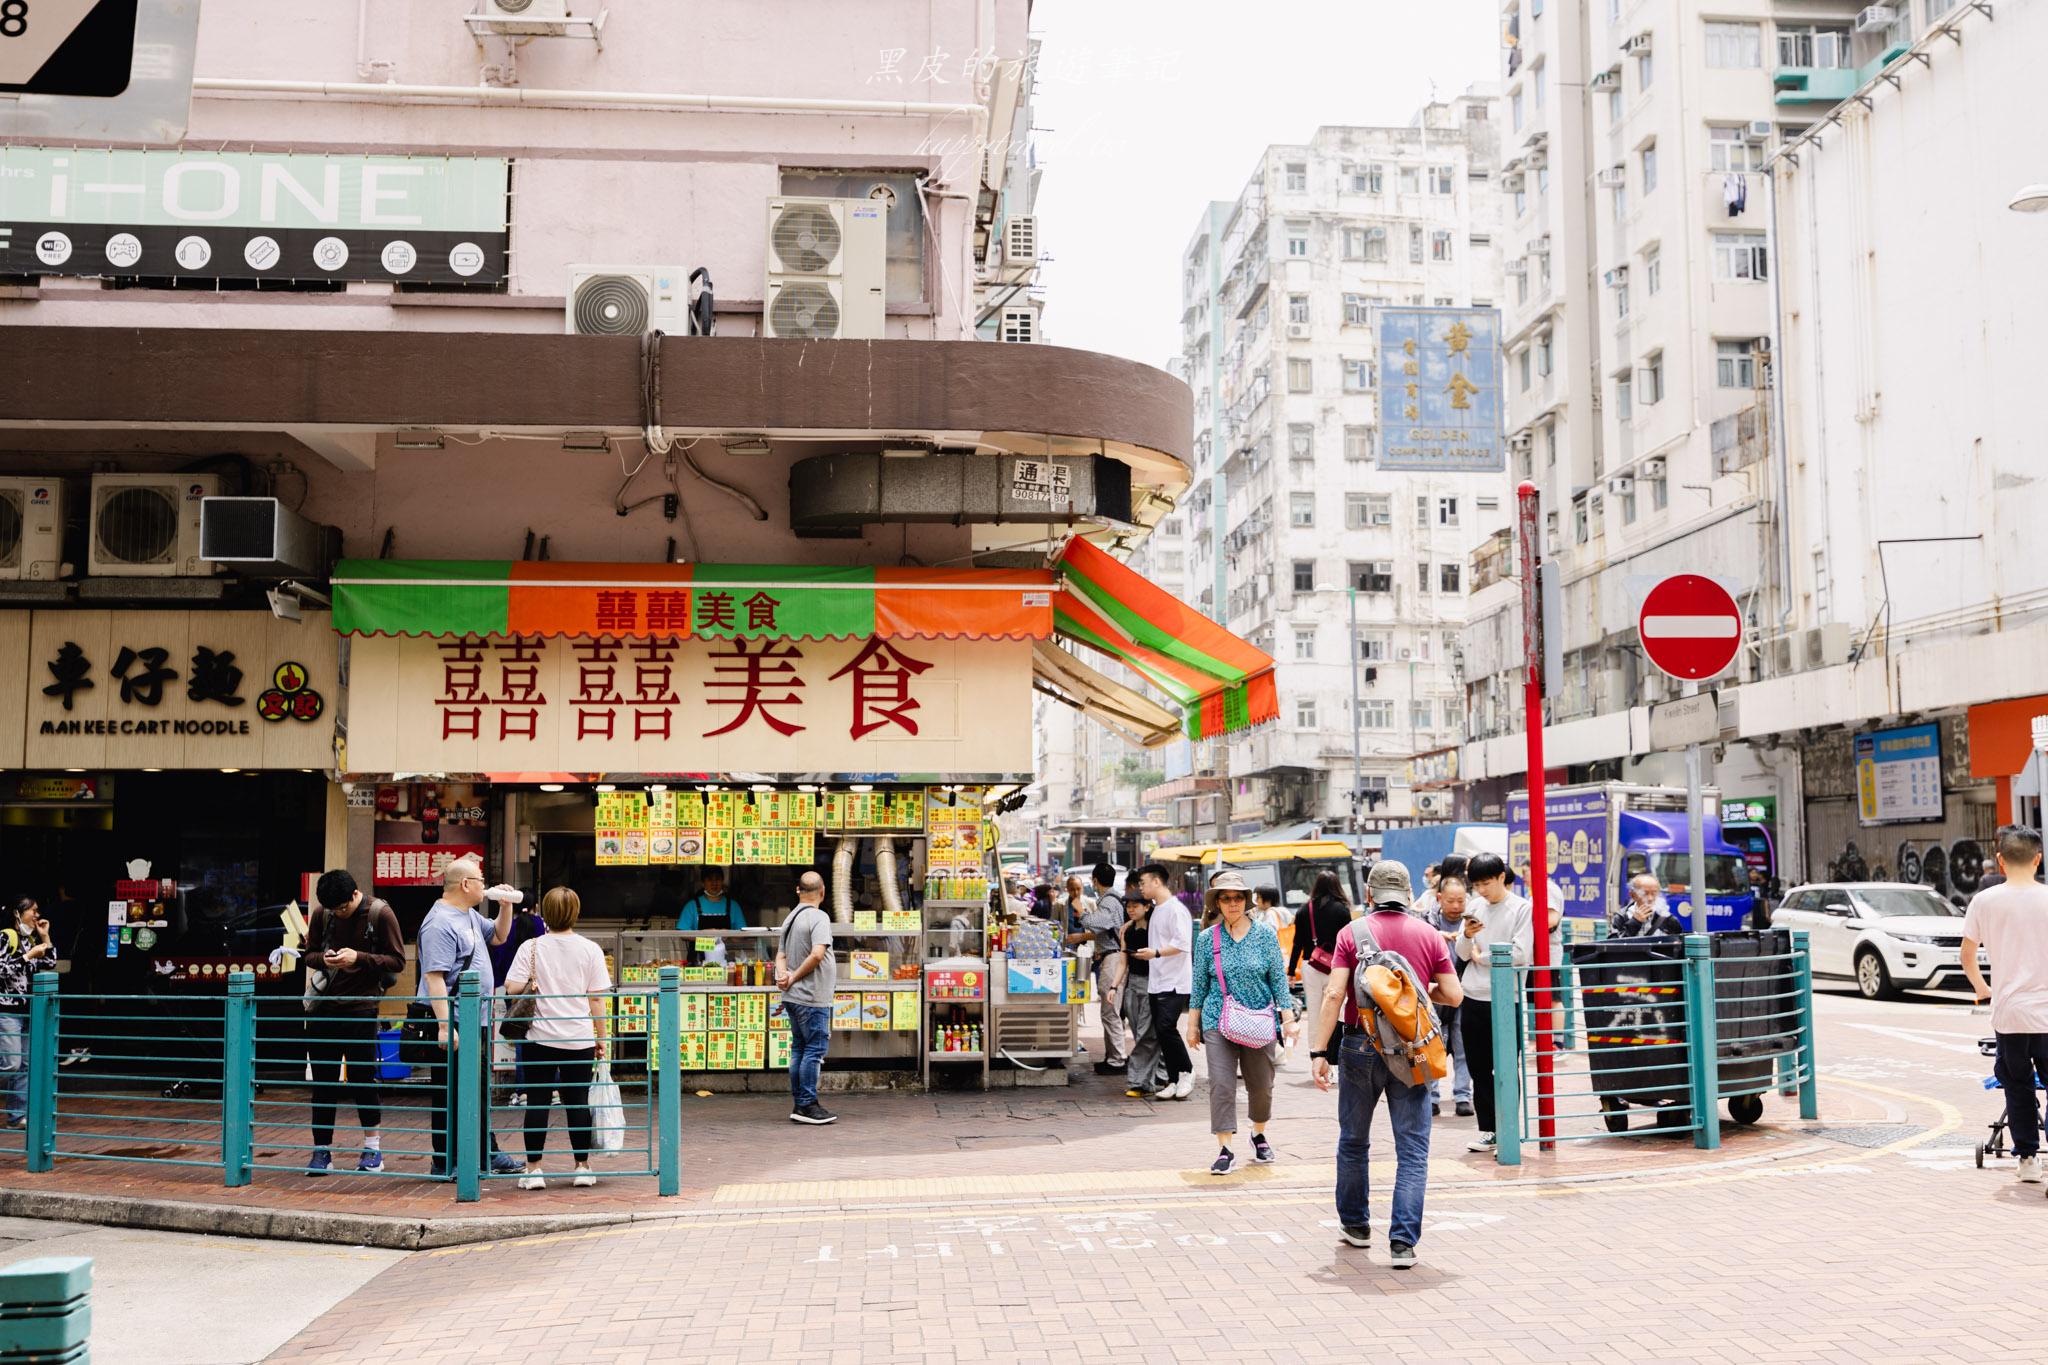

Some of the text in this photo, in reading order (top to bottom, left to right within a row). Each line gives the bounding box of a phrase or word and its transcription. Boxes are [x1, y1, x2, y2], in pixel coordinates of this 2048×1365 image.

[0, 0, 28, 37] 8
[50, 157, 424, 225] i-ONE
[1443, 320, 1480, 409] 黃金
[1389, 447, 1491, 458] COMPUTER ARCADE
[1408, 427, 1469, 441] GOLDEN
[1015, 489, 1067, 504] 9081780
[595, 591, 781, 632] 囍囍美食
[434, 637, 935, 742] 囍囍美食
[39, 719, 250, 735] MAN KEE CART NOODLE
